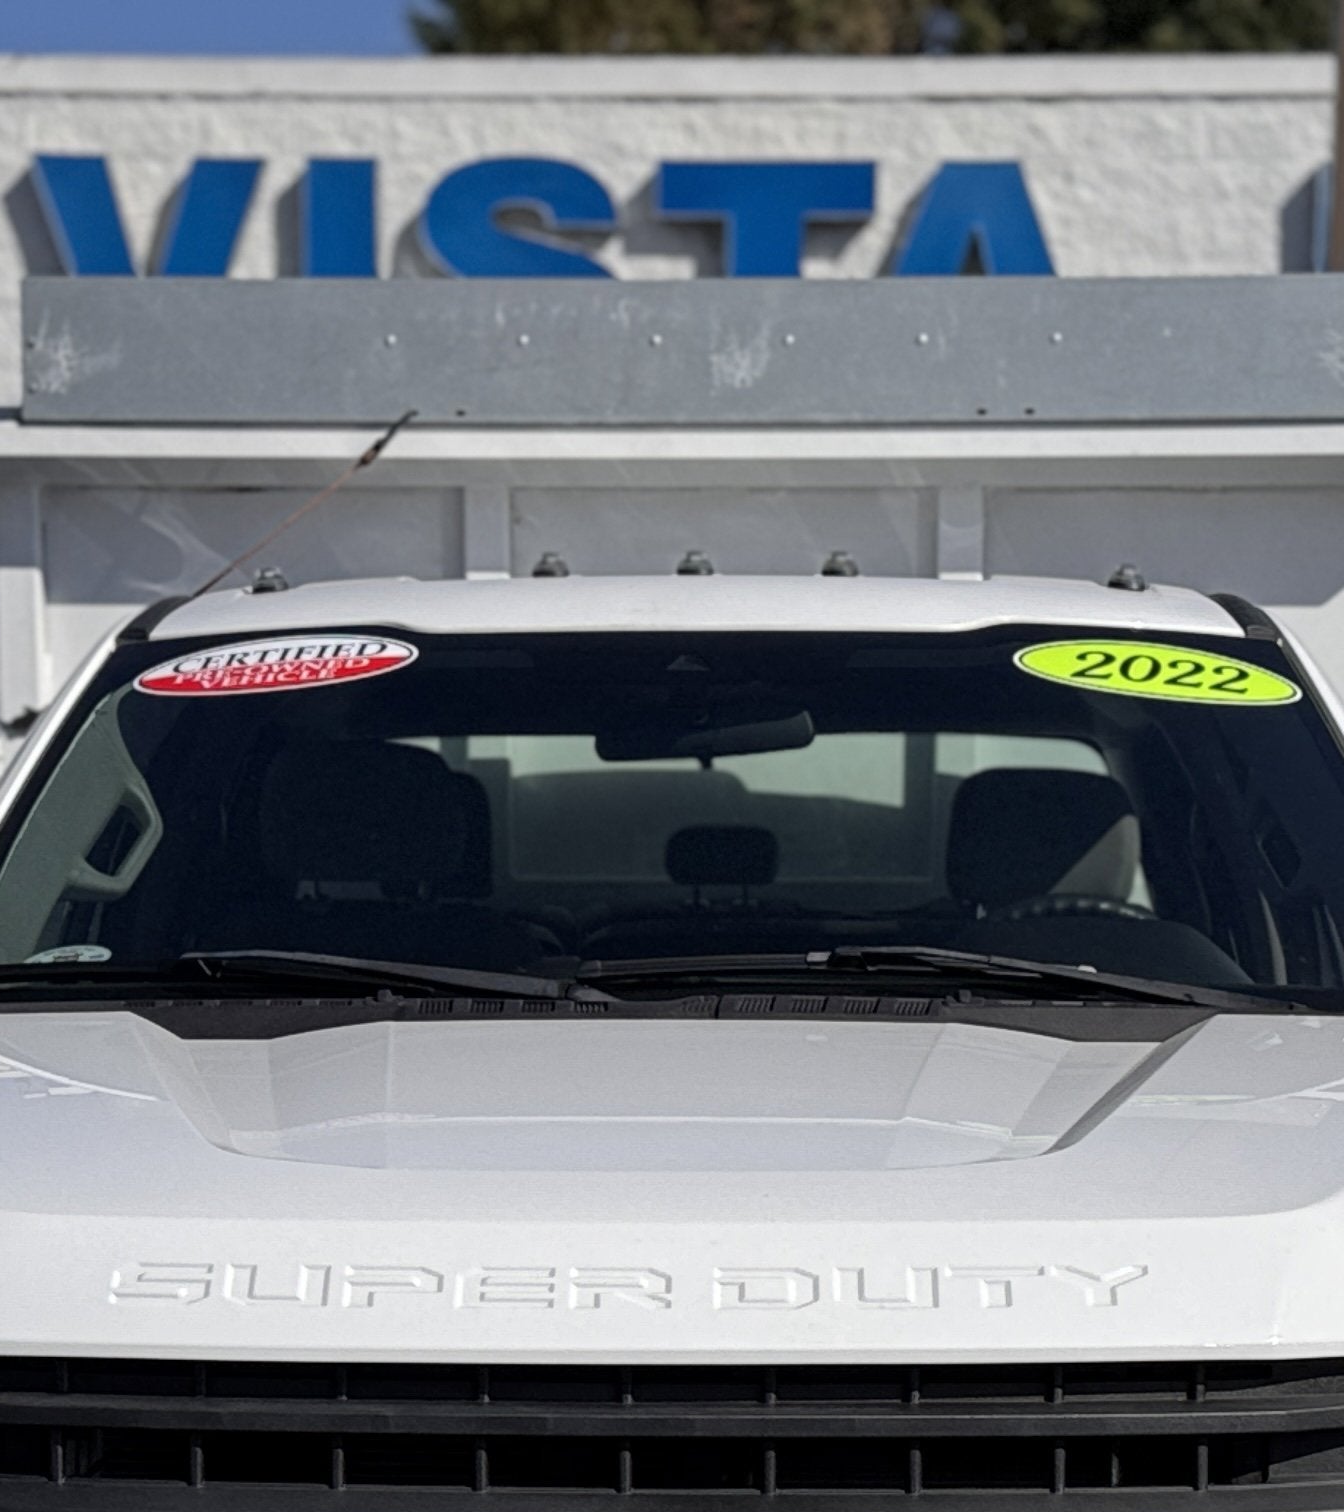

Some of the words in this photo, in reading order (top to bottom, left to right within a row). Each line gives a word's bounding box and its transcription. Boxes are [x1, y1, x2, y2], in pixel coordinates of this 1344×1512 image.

[172, 642, 388, 674] CERTIFIED
[172, 657, 371, 685] PRE-OWNED
[1069, 650, 1250, 695] 2022
[200, 668, 338, 689] VEHICLE
[107, 1262, 673, 1310] SUPER
[712, 1263, 1150, 1310] DUTY
